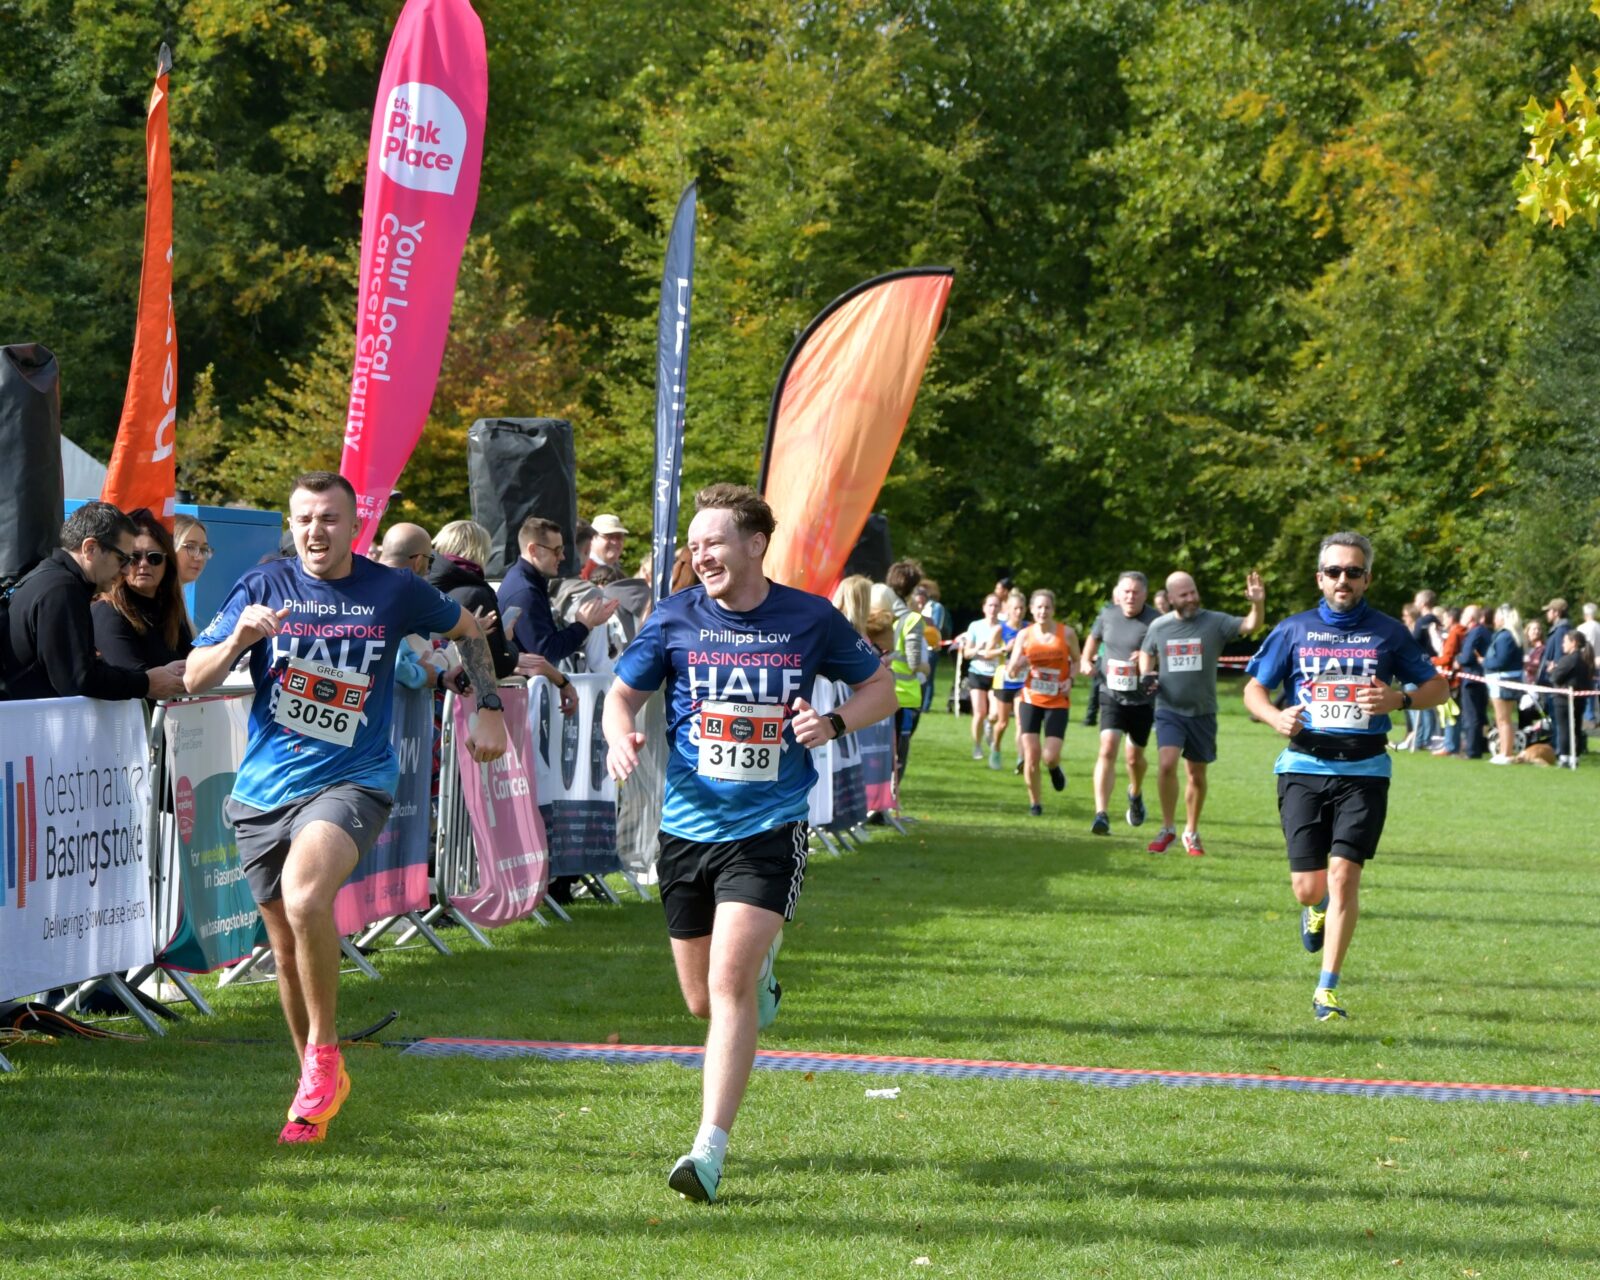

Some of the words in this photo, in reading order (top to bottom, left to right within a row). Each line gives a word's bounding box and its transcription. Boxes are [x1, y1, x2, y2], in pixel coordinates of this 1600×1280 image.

[388, 111, 441, 145] Pink
[383, 136, 453, 171] Place
[391, 220, 425, 291] Your
[366, 213, 399, 326] Cancer
[371, 296, 407, 381] Local
[344, 333, 374, 451] Charity
[284, 599, 337, 617] Phillips
[342, 602, 375, 615] Law
[273, 622, 386, 639] ASINGSTOKE
[700, 629, 753, 646] Phillips
[758, 630, 791, 643] Law
[1307, 632, 1344, 645] Phillips
[1347, 634, 1372, 644] Law
[272, 636, 386, 674] HALF
[688, 651, 802, 667] BASINGSTOKE
[1172, 656, 1198, 667] 3217
[1299, 648, 1377, 659] BASINGSTOKE
[317, 665, 344, 679] GREG
[1299, 657, 1378, 682] HALF
[688, 667, 802, 703] HALF
[287, 699, 349, 733] 3056
[733, 705, 754, 714] ROB
[1320, 704, 1362, 720] 3073
[709, 744, 770, 769] 3138
[46, 808, 143, 887] Basingstoke
[204, 872, 213, 889] in
[214, 865, 247, 887] Basingstok
[43, 911, 85, 940] Delivering
